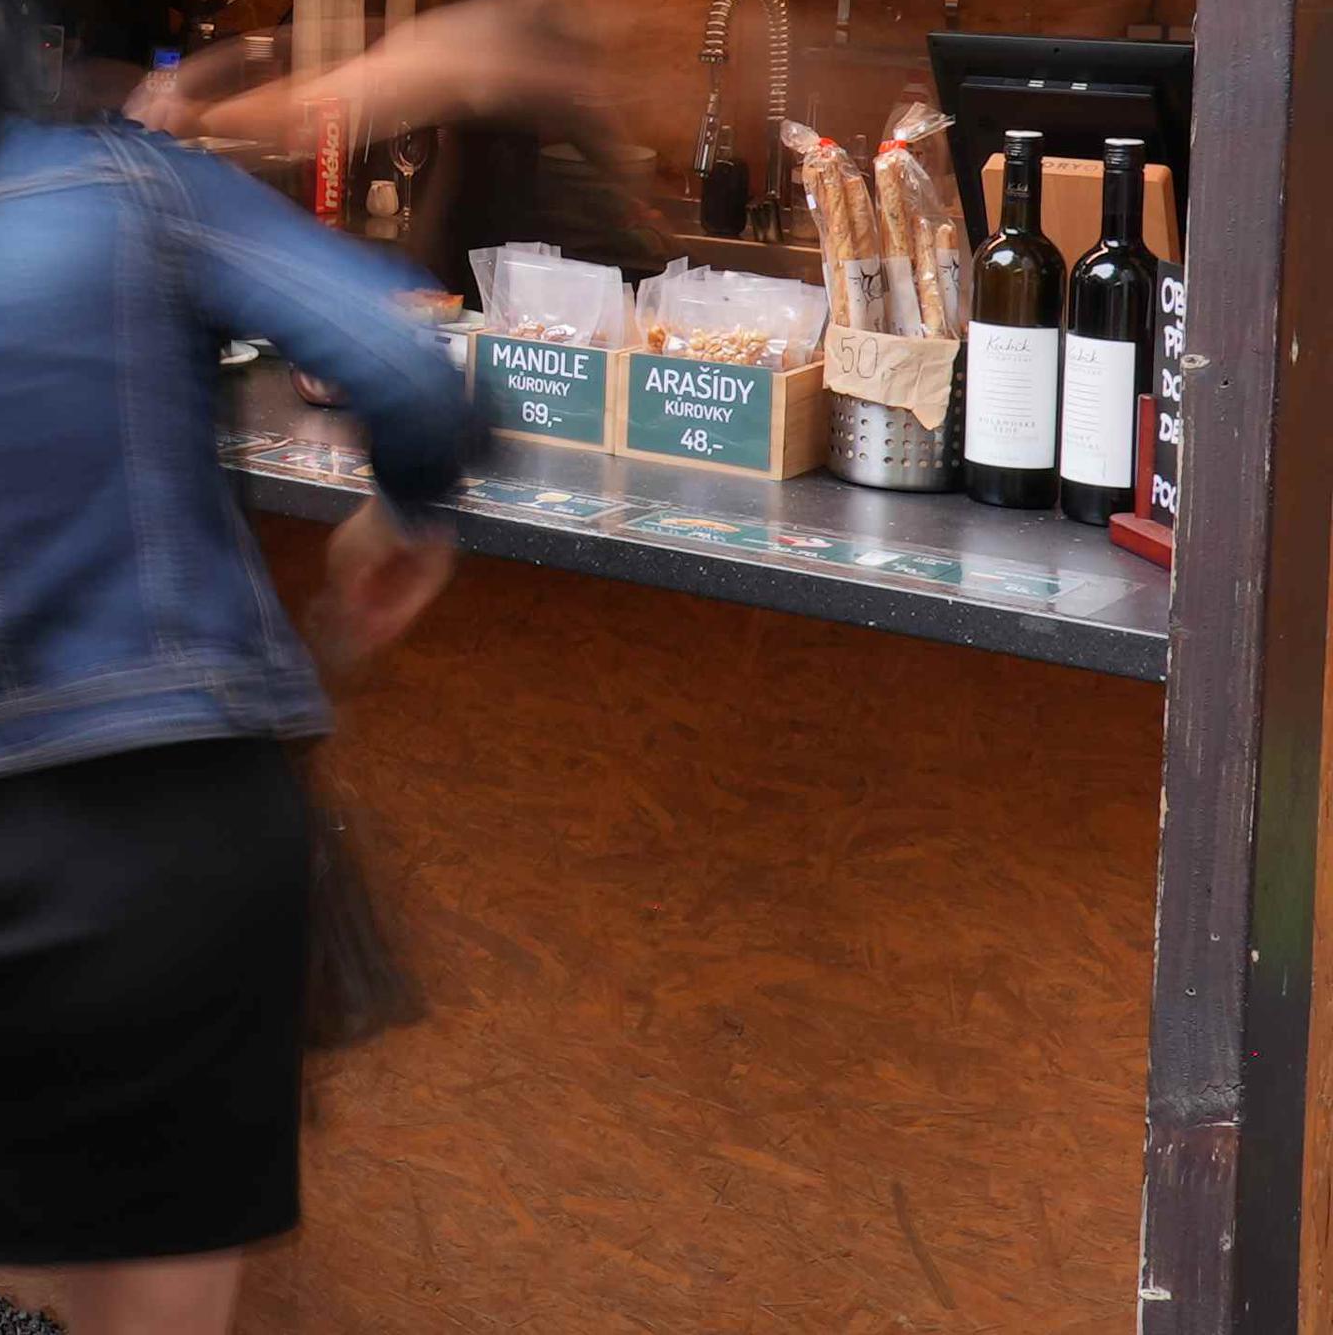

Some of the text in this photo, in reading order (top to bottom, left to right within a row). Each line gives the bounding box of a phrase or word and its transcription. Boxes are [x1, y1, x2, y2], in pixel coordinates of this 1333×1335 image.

[493, 343, 590, 380] MANDLE
[508, 374, 571, 397] KŮROVKY
[645, 364, 755, 405] ARAŠÍDY
[522, 401, 562, 428] 69,-
[664, 397, 733, 423] KŮROVKY
[680, 427, 723, 455] 48,-
